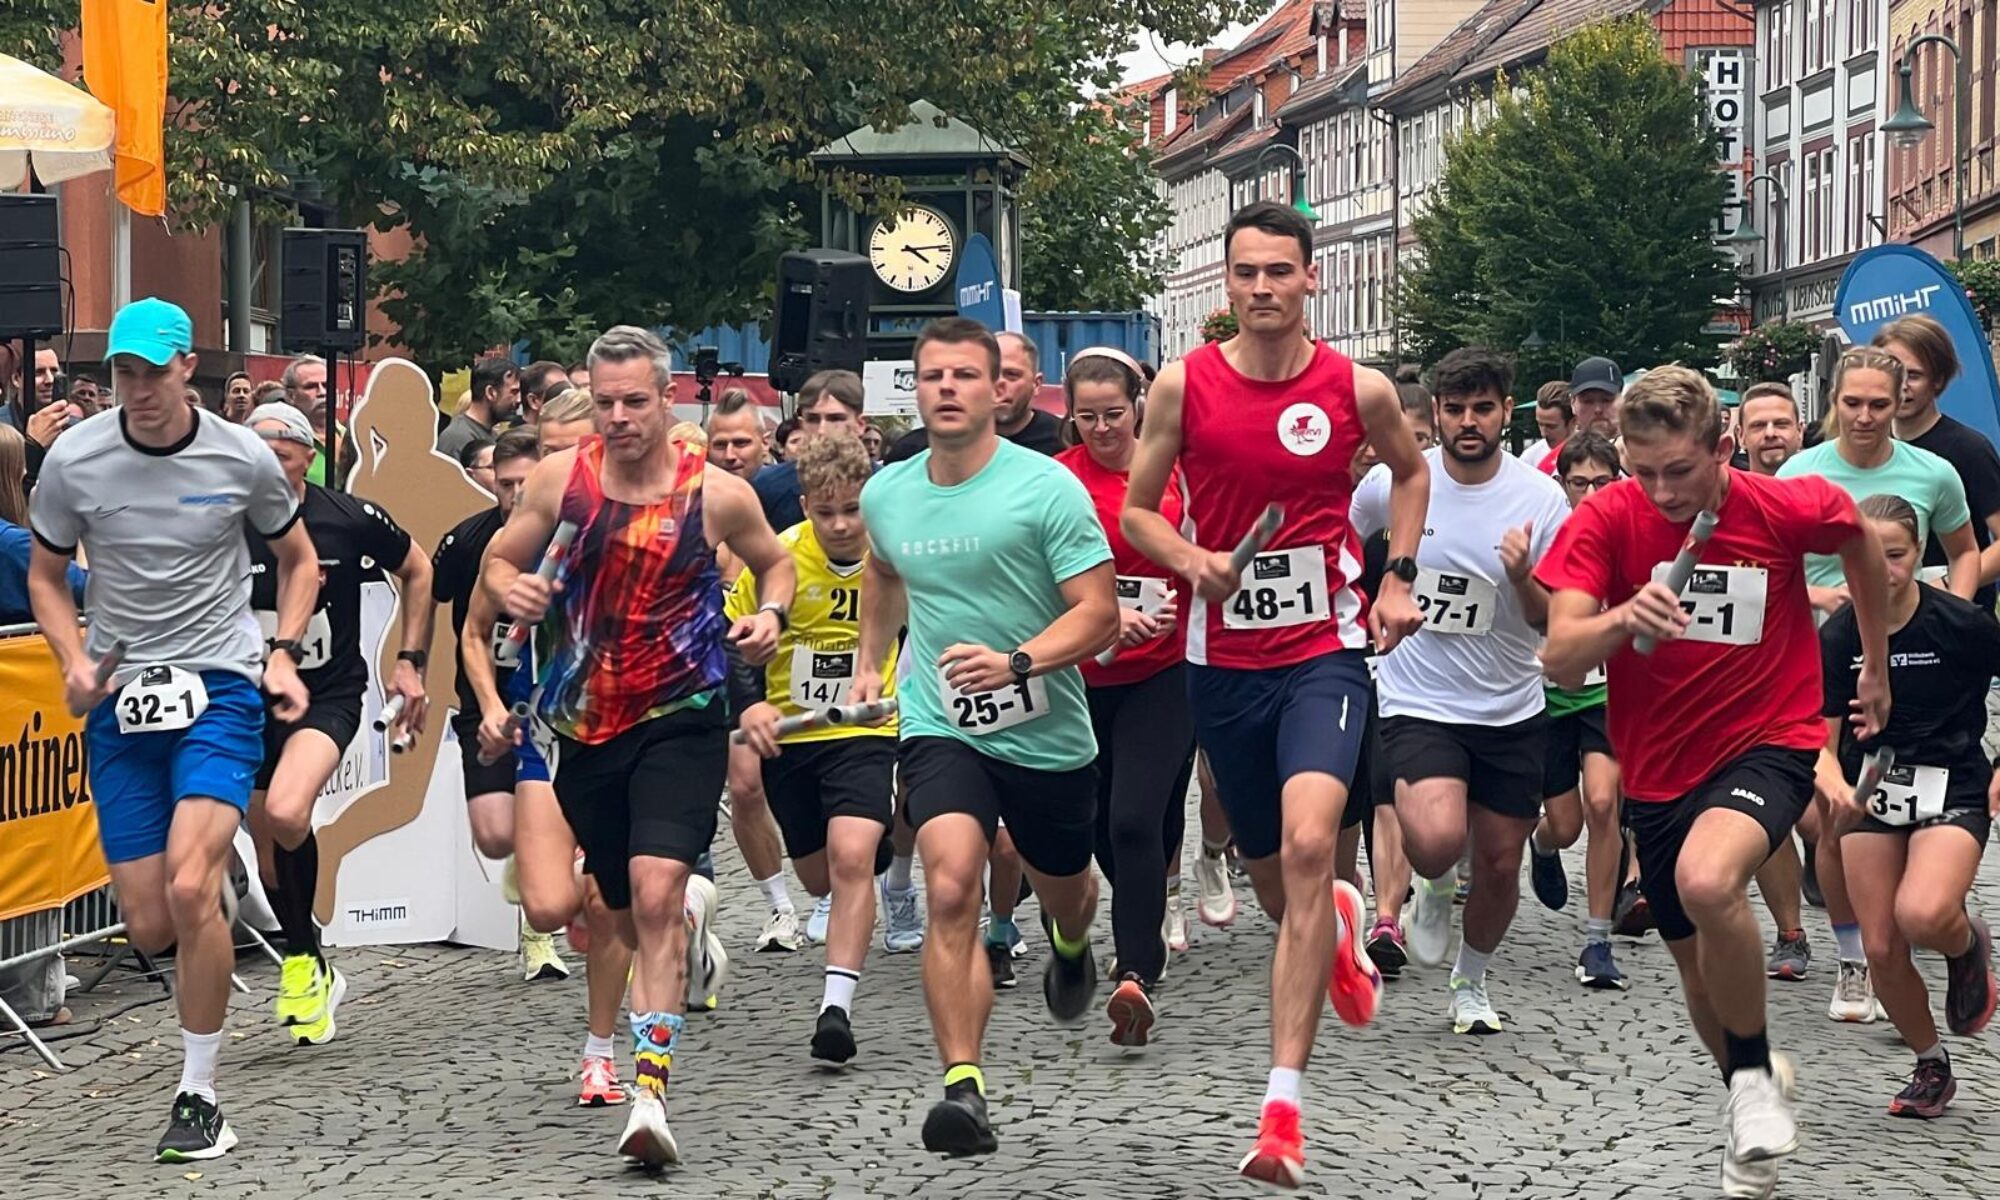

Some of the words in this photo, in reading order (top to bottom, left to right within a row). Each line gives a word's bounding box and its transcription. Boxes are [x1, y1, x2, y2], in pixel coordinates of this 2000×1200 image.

[1233, 582, 1313, 621] 48-1
[1416, 595, 1480, 628] 27-1
[123, 690, 195, 726] 32-1
[953, 681, 1034, 728] 25-1
